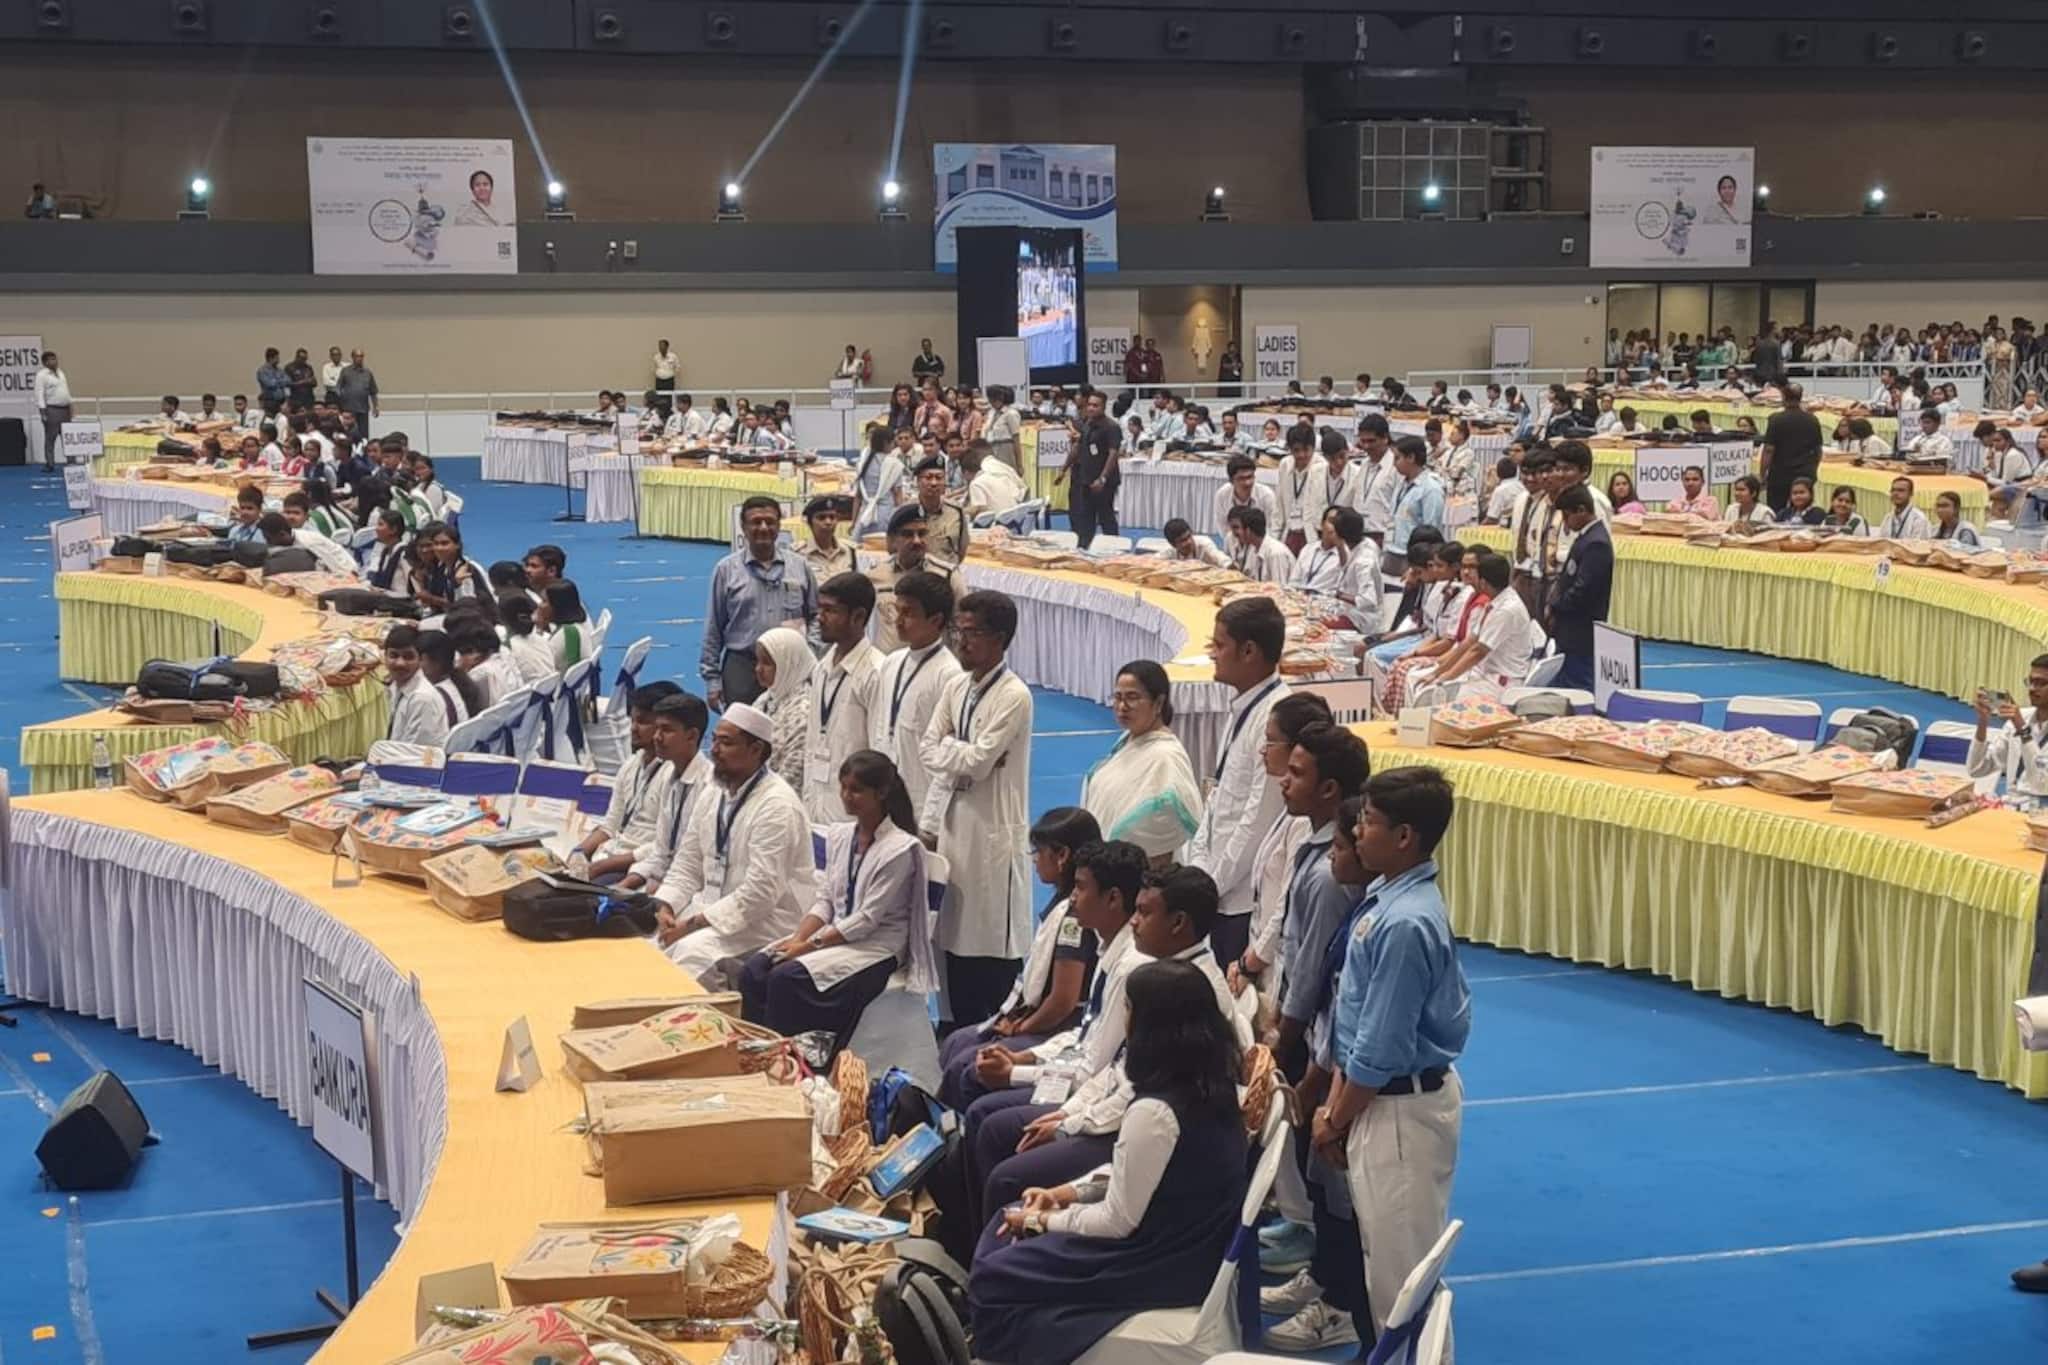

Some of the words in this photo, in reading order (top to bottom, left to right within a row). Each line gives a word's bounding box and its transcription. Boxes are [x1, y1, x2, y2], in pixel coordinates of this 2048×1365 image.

[1091, 338, 1128, 354] GENTS
[1257, 336, 1296, 352] LADIES
[1259, 361, 1296, 377] TOILET
[1039, 440, 1070, 456] BARASA
[1713, 448, 1751, 462] KOLKATA
[1600, 655, 1631, 688] NADIA
[310, 1031, 370, 1136] BANKURA
